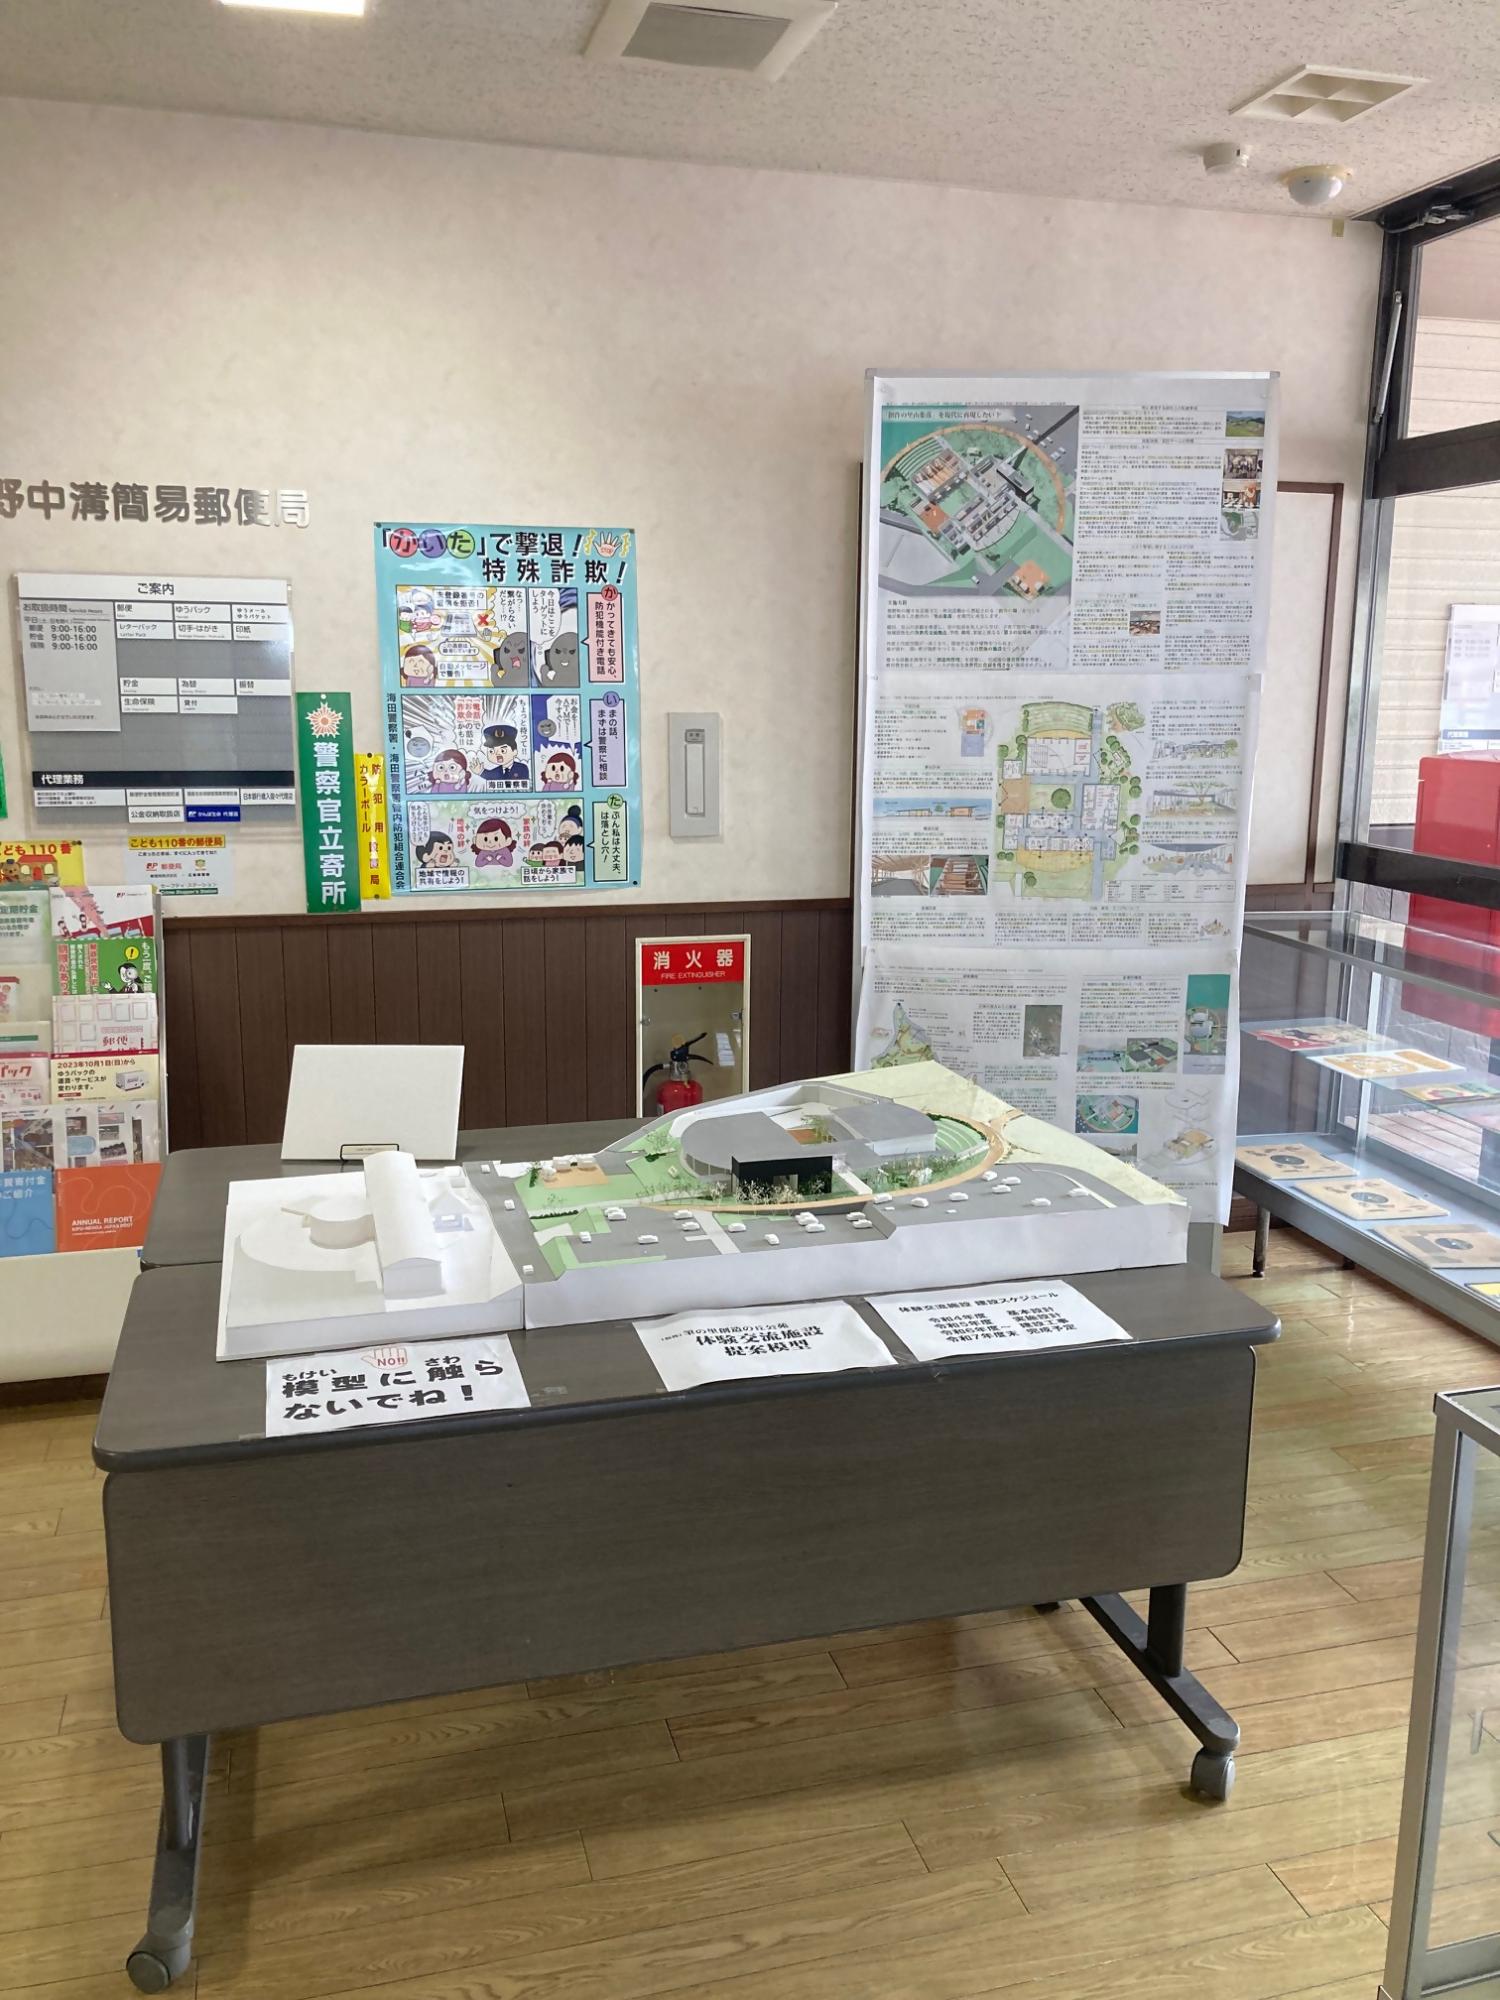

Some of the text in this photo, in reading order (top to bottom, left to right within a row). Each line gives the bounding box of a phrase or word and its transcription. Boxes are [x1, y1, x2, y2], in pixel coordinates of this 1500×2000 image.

[482, 557, 626, 584] 特殊詐欺!
[137, 582, 175, 595] ご案内
[117, 604, 132, 612] 郵便
[175, 606, 211, 614] ゆうパック
[51, 625, 96, 633] 9:00-16:00
[119, 623, 157, 631] レターパック
[235, 625, 251, 634] 印紙
[51, 634, 97, 642] 9:00-16:00
[595, 602, 606, 675] 防犯機能付き電話
[123, 679, 138, 688] 貯金
[598, 709, 608, 781] まずは警察に相談
[41, 774, 84, 785] 代理業務
[359, 764, 371, 833] カラーボール
[313, 742, 347, 905] 警察官立寄所
[0, 840, 71, 855] ども110番
[130, 837, 223, 848] こども110番の郵便局
[161, 862, 182, 870] 郵便局
[653, 948, 734, 970] 消火器
[678, 970, 726, 979] EXTINGUISHER
[57, 1059, 136, 1069] 2023年10月1日(日)から
[57, 1069, 96, 1077] ゆうパックの
[72, 1215, 133, 1226] ANNUAL REPORT
[899, 1292, 1059, 1313] 体験交流施設 建設スケジュール
[928, 1306, 1054, 1324] 令和4年度 基本設計
[1012, 1312, 1061, 1322] 実施設計
[1019, 1318, 1069, 1329] 建設工事
[1026, 1323, 1078, 1335] 完成予定
[696, 1326, 824, 1346] 体験交流施設
[724, 1339, 812, 1357] 提案模型
[424, 1355, 461, 1367] さわ
[282, 1368, 338, 1380] もけい
[282, 1359, 503, 1398] 模型に触ら
[283, 1384, 474, 1420] ないでね!
